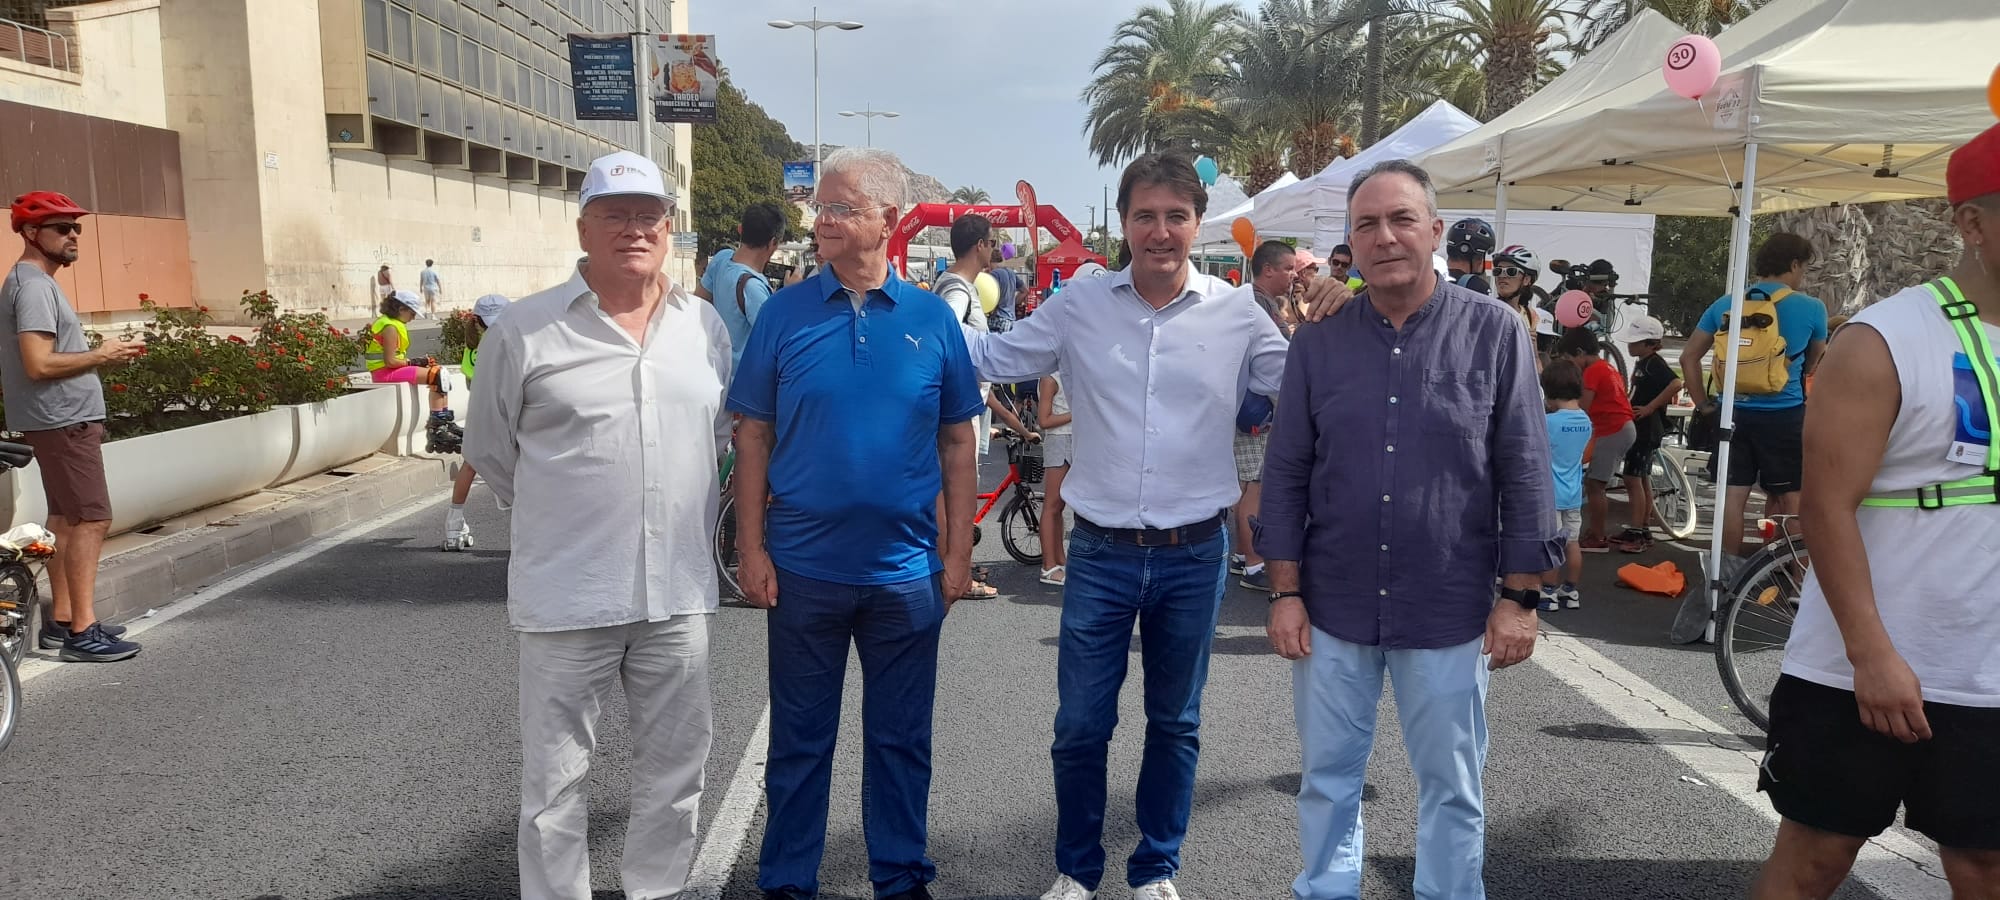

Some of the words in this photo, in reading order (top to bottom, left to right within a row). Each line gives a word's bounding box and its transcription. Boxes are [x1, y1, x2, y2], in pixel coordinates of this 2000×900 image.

[1672, 48, 1690, 63] 30
[1580, 304, 1590, 314] 30
[1561, 425, 1590, 433] ESCUELA
